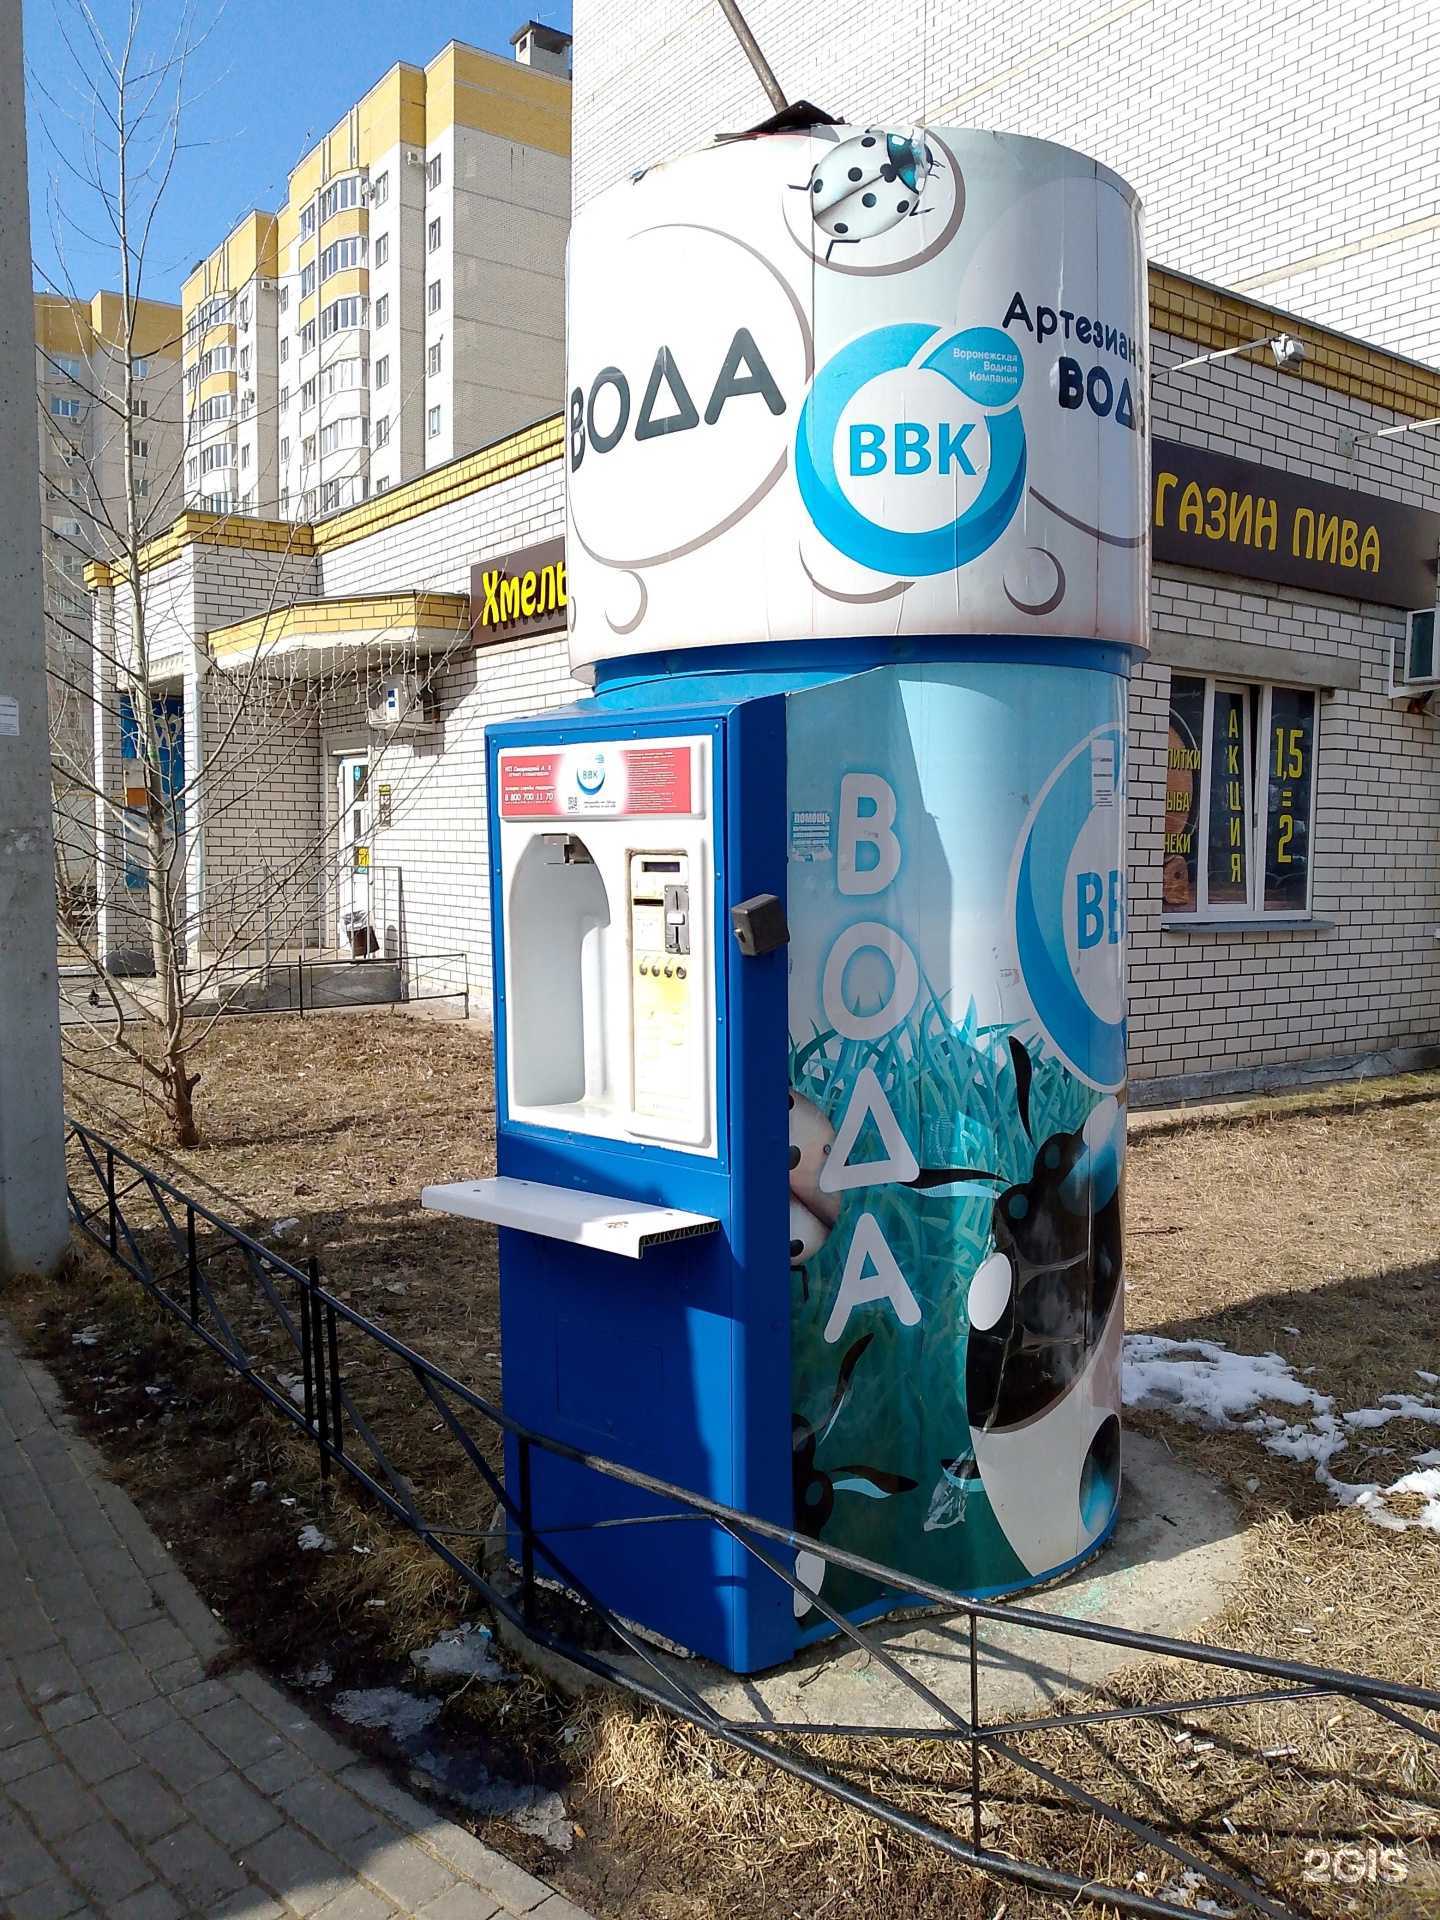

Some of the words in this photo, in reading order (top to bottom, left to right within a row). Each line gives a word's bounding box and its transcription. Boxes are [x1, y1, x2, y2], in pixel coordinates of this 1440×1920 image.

[953, 347, 1018, 362] Воронежская
[969, 371, 1018, 385] Компания
[983, 361, 1018, 374] Водная
[571, 327, 787, 473] ВОДА
[849, 422, 976, 476] ВВК
[1155, 472, 1277, 550] ГАЗИН
[1292, 507, 1380, 573] ПИВА
[1276, 728, 1304, 781] 1,5
[1228, 709, 1241, 882] АКЦИЯ
[1278, 814, 1293, 863] 2
